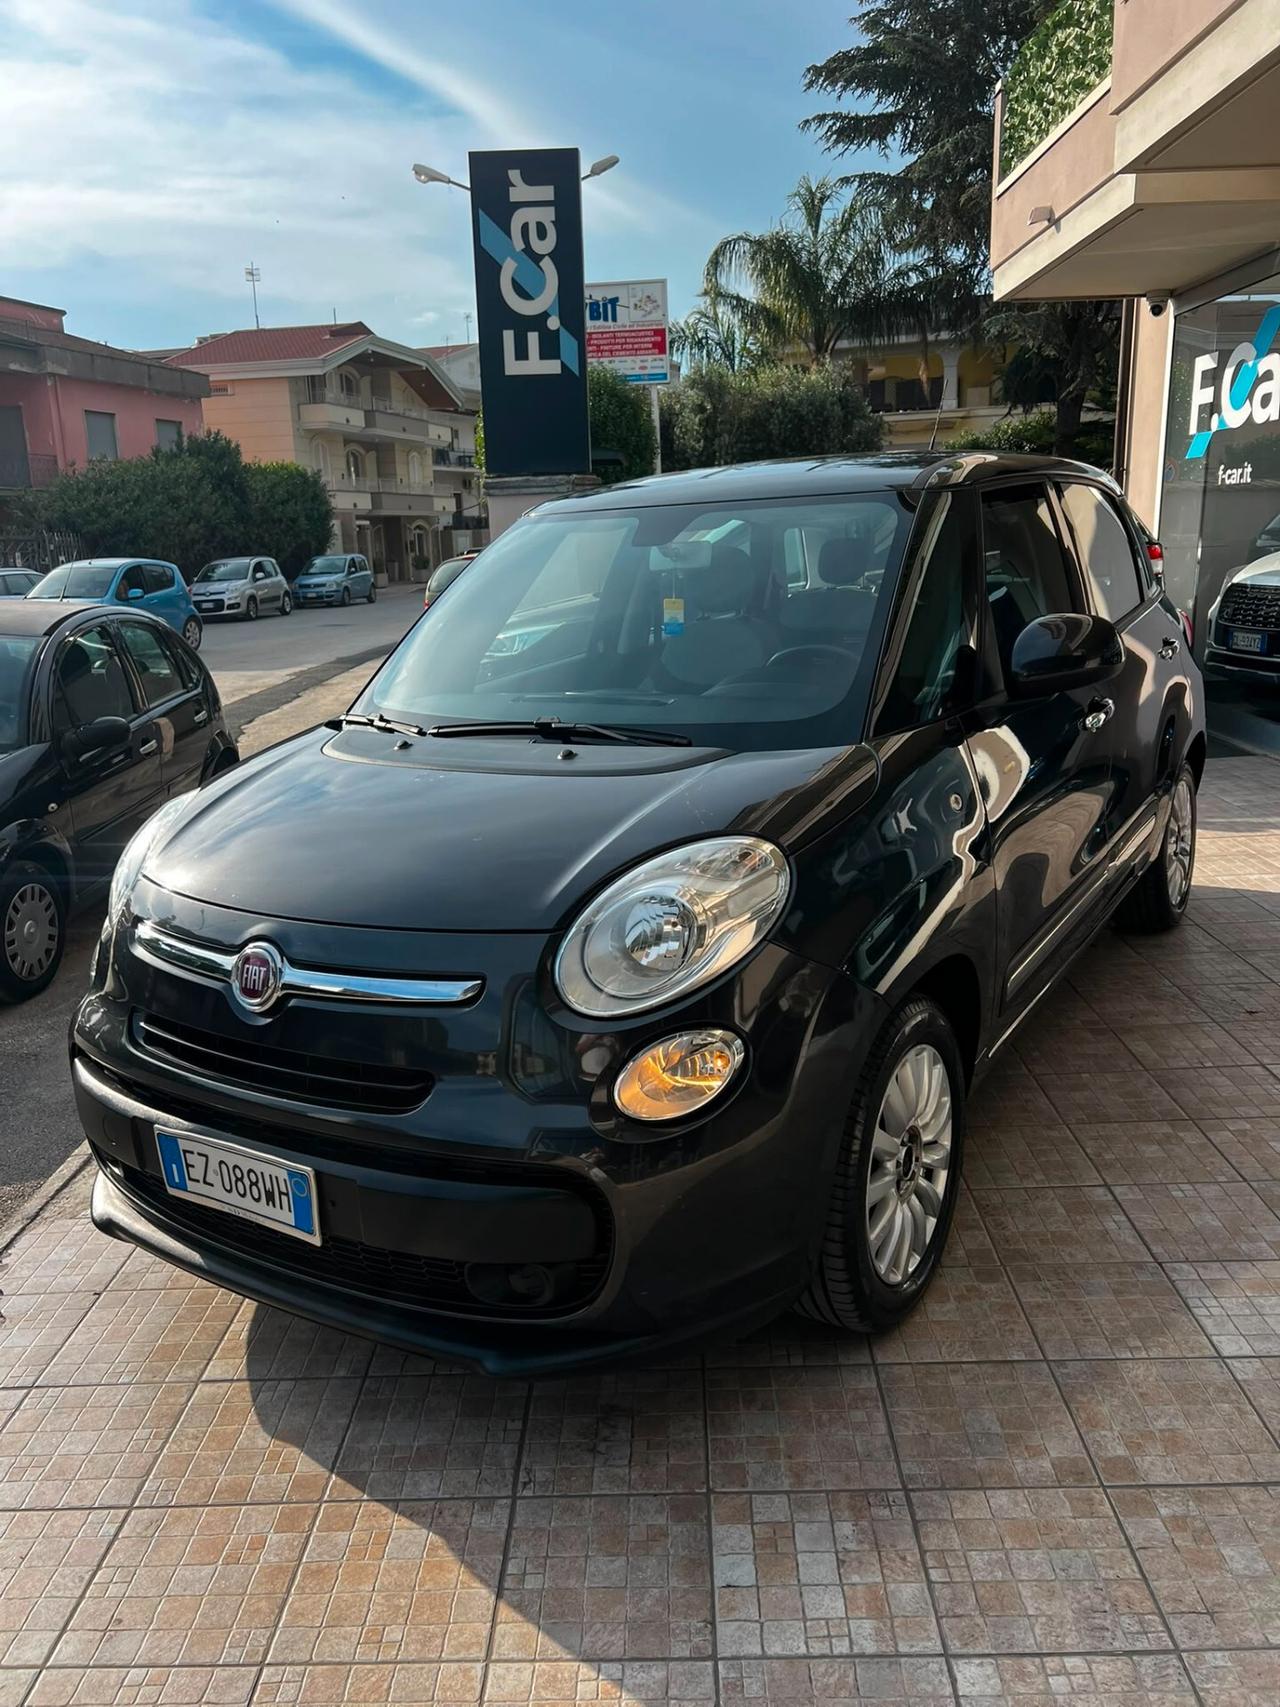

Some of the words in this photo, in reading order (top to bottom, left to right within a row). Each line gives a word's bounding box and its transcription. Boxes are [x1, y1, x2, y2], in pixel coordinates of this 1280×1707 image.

[500, 169, 562, 376] F.Car
[1218, 462, 1252, 486] f-car.it
[242, 964, 267, 990] FIAT
